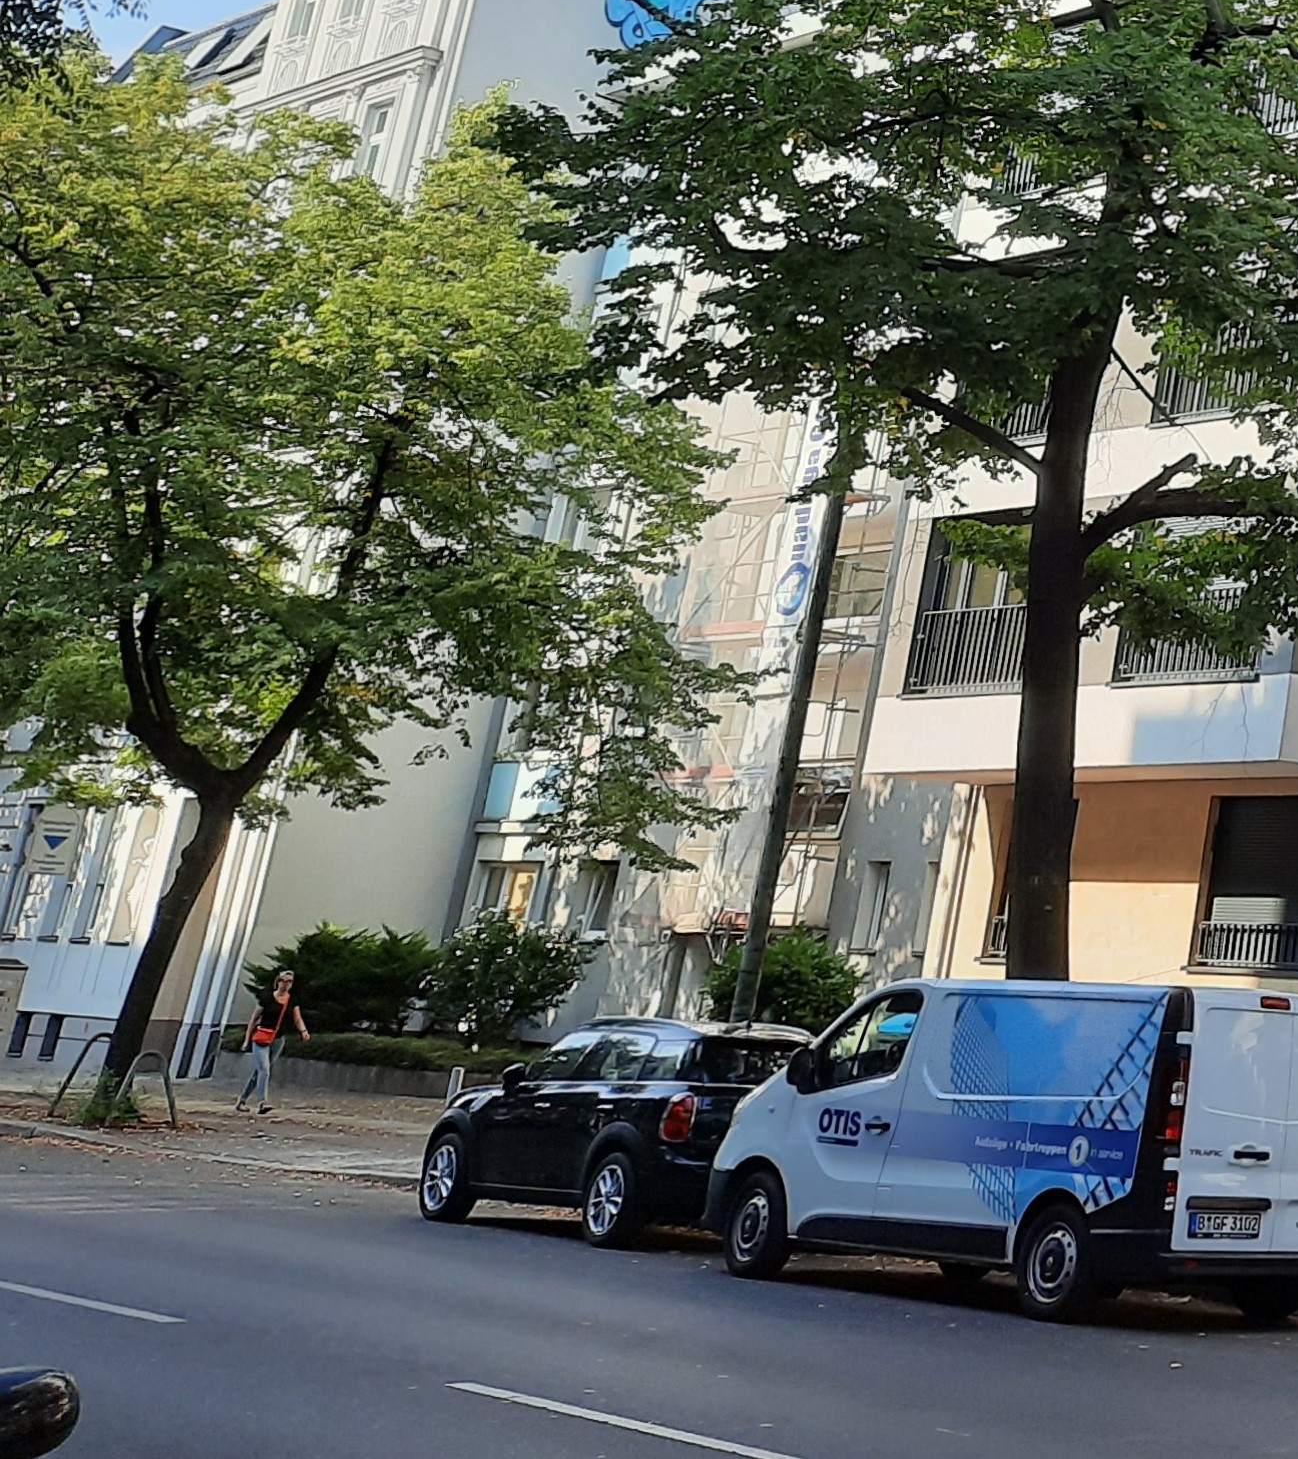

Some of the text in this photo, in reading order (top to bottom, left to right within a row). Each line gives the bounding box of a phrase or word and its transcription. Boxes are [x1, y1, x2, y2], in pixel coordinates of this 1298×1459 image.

[818, 1107, 862, 1137] OTIS
[1197, 1215, 1259, 1232] B GF 3102
